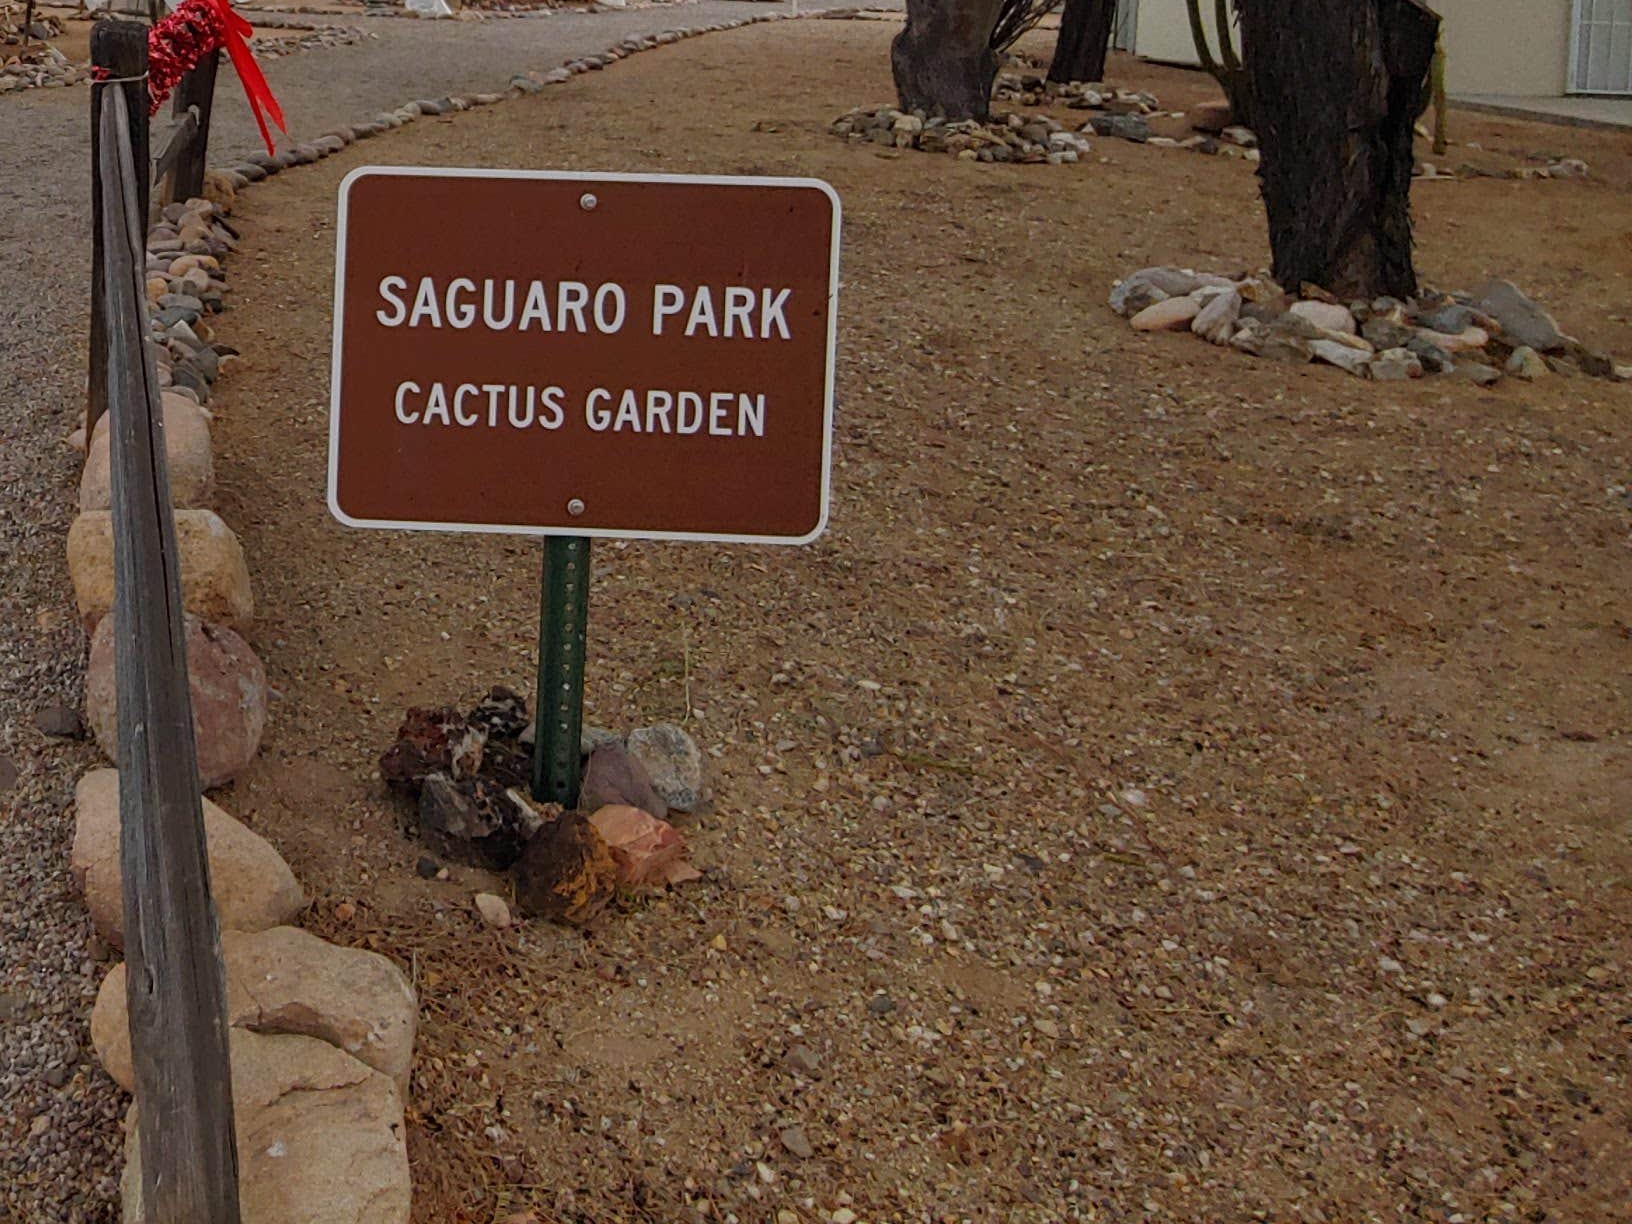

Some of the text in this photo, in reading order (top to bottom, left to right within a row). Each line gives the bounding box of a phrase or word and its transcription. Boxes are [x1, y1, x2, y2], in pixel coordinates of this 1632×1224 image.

[375, 275, 793, 340] SAGUARO PARK
[394, 380, 766, 438] CACTUS GARDEN
